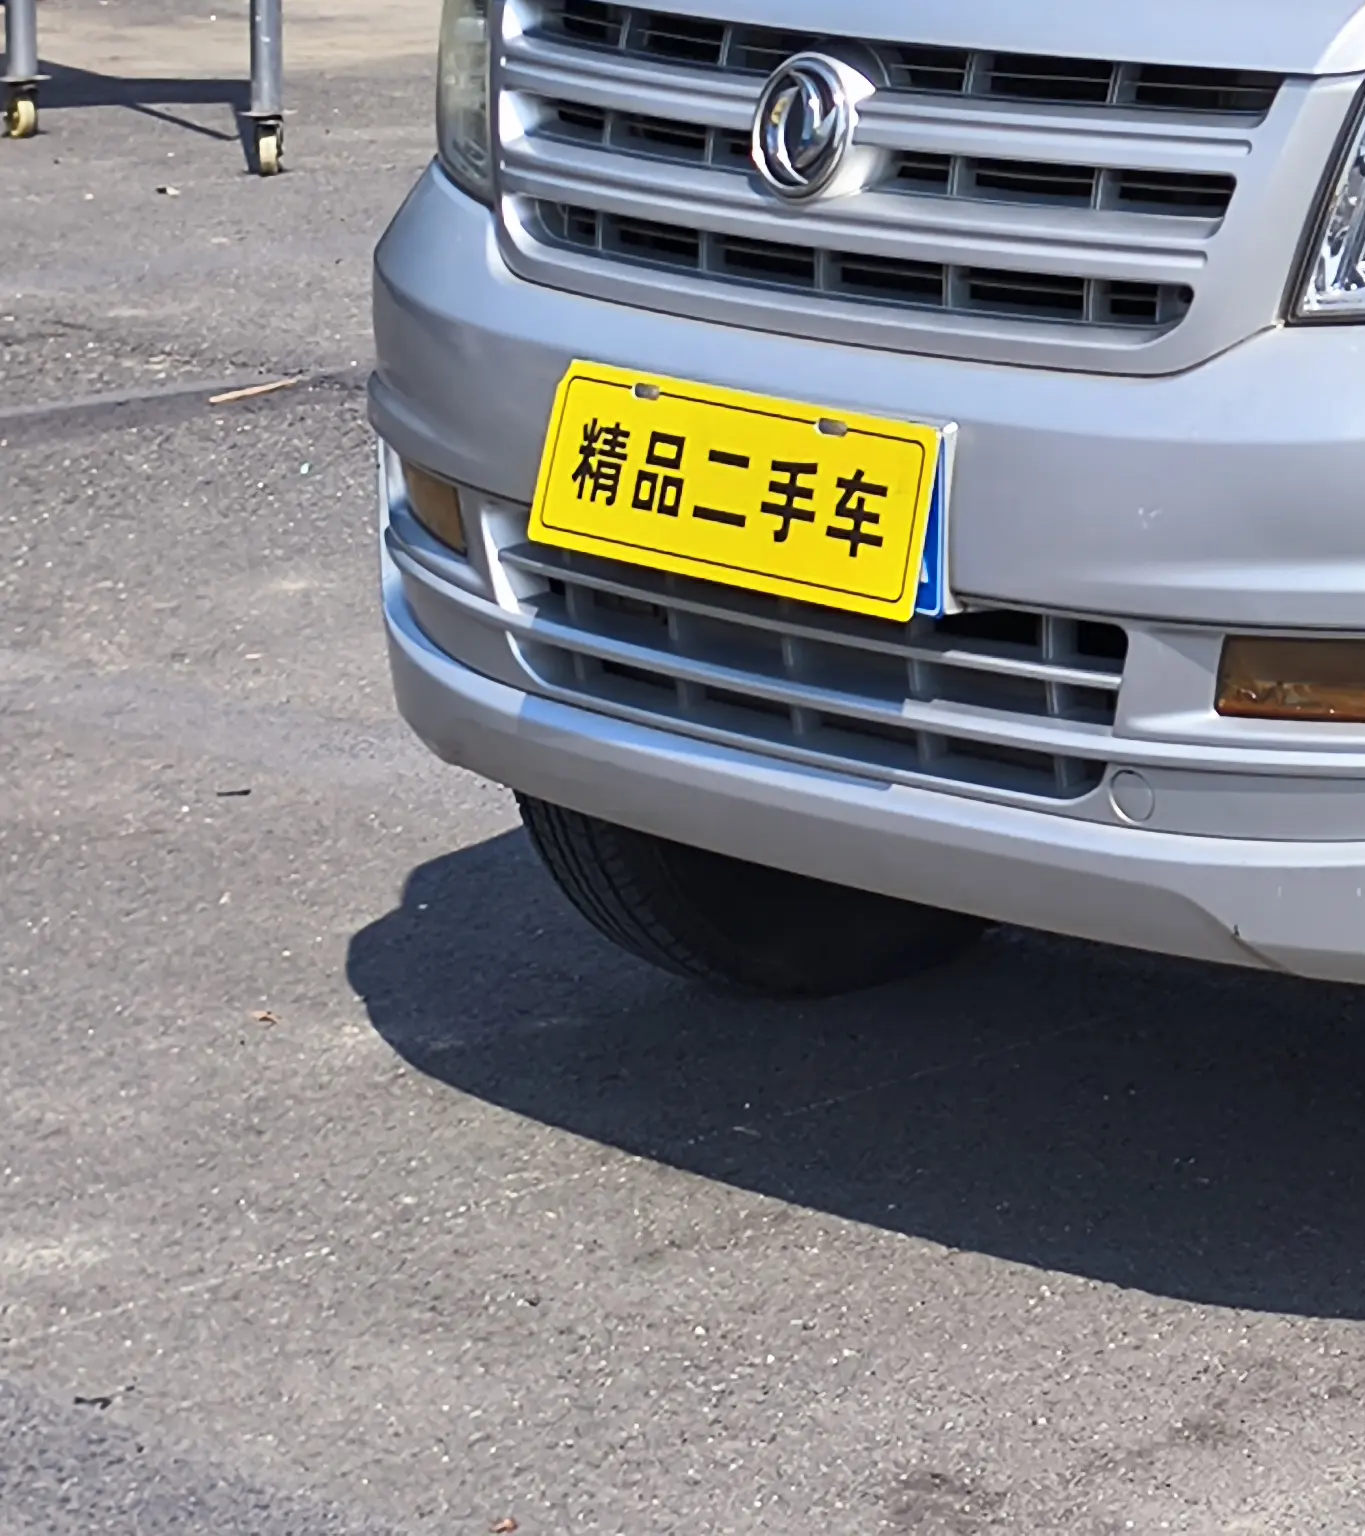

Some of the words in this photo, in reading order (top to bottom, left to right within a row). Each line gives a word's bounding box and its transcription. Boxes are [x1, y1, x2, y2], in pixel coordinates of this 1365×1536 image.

[570, 416, 889, 559] 精品二手车
